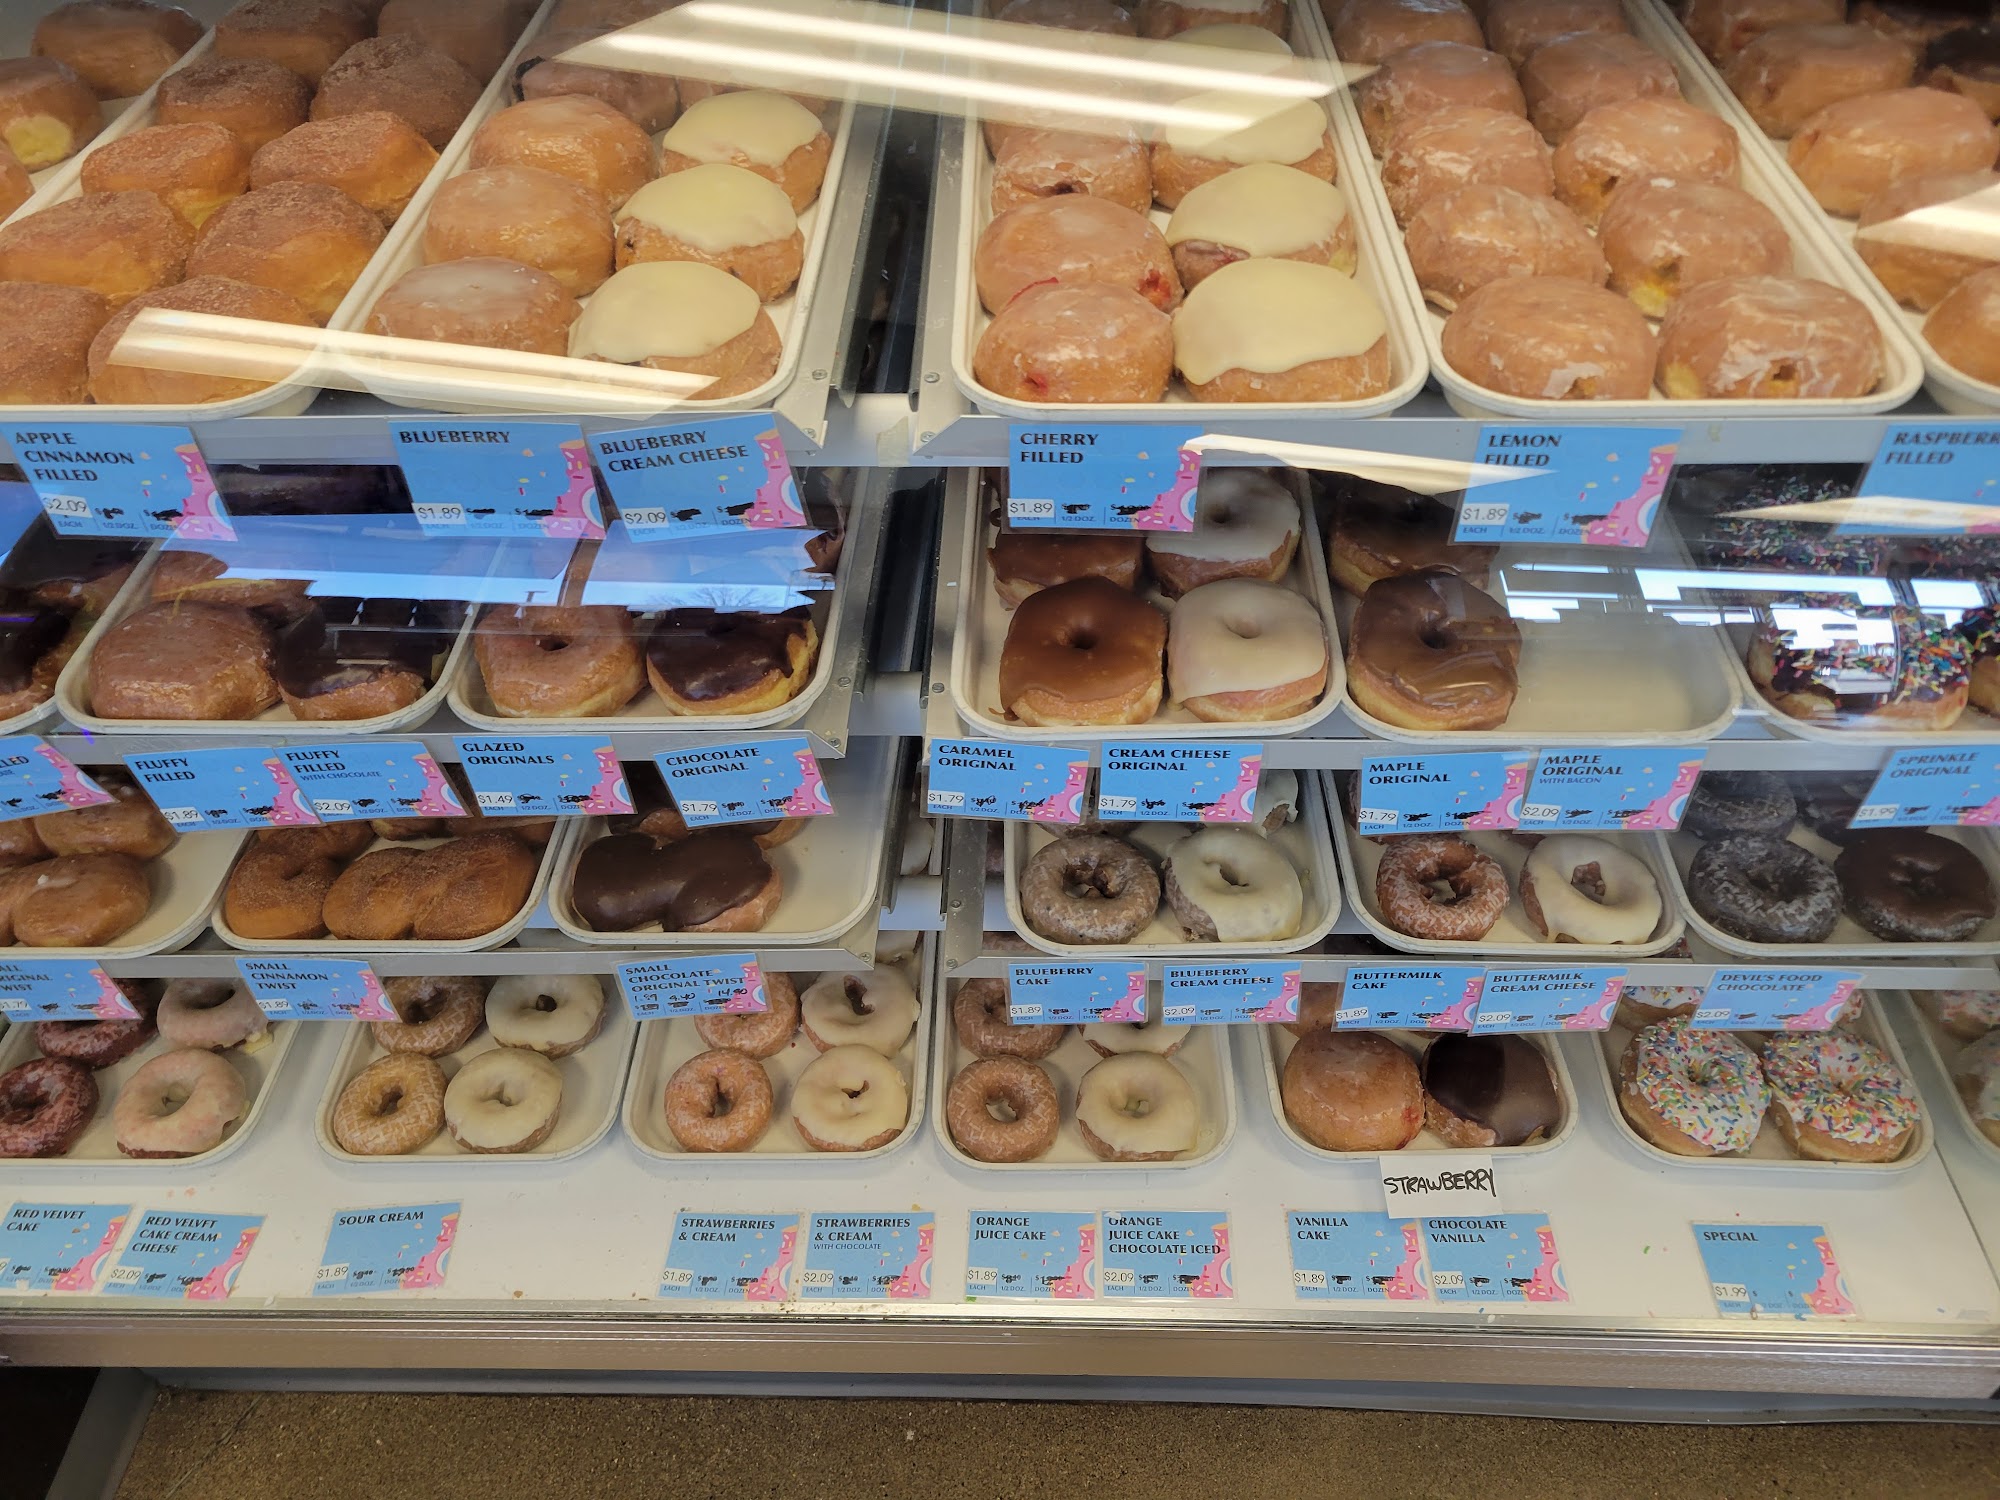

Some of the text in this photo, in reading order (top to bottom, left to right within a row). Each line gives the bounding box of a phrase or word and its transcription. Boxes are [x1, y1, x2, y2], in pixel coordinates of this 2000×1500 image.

[16, 432, 77, 445] APPLE
[400, 431, 510, 443] BLUEBERRY
[1020, 433, 1099, 445] CHERRY
[1488, 435, 1562, 447] LEMON
[600, 431, 706, 455] BLUEBERRY
[24, 450, 135, 465] CINNAMON
[609, 446, 749, 472] CREAM CHEESE
[1021, 452, 1084, 464] FILLED
[1485, 454, 1549, 466] FILLED
[1885, 452, 1954, 464] FILLED
[34, 469, 98, 481] FILLED
[43, 497, 87, 513] $2.09
[1010, 502, 1053, 514] $1.89
[418, 508, 461, 519] $1.89
[624, 511, 666, 524] $2.09
[1462, 508, 1507, 521] $1.89
[462, 743, 524, 752] GLAZED
[939, 745, 1015, 759] CARAMEL
[286, 750, 340, 761] FLUFFY
[666, 748, 760, 766] CHOCOLATE
[1109, 749, 1231, 759] CREAM CHEESE
[1897, 752, 1979, 765] SPRINKLE
[135, 758, 189, 770] FLUFFY
[468, 756, 555, 765] ORIGINALS
[939, 757, 1016, 771] ORIGINAL
[1545, 755, 1602, 765] MAPLE
[294, 763, 345, 773] FILLED
[672, 763, 749, 778] ORIGINAL
[1108, 761, 1187, 771] ORIGINAL
[1370, 762, 1425, 772] MAPLE
[1542, 766, 1623, 776] ORIGINAL
[144, 771, 195, 782] FILLED
[327, 771, 382, 779] CHOCOLATE
[1890, 765, 1972, 778] ORIGINAL
[1370, 774, 1451, 784] ORIGINAL
[478, 795, 513, 804] $1.49
[929, 793, 964, 803] $1.79
[1101, 798, 1136, 808] $1.79
[315, 802, 351, 811] $2.09
[682, 803, 717, 812] $1.79
[164, 810, 198, 821] $1.89
[1359, 811, 1397, 821] $1.79
[1522, 807, 1559, 817] $2.09
[626, 965, 672, 974] SMALL
[1016, 967, 1094, 976] BLUEBERRY
[1171, 968, 1250, 978] BLUEBERRY
[629, 970, 713, 983] CHOCOLATE
[1354, 972, 1443, 980] BUTTERMILK
[1493, 973, 1583, 982] BUTTERMILK
[632, 981, 700, 992] ORIGINAL
[1337, 1009, 1368, 1019] $1.89
[1479, 1014, 1510, 1022] $2.09
[1384, 1168, 1496, 1197] STRAWBERRY
[14, 1209, 85, 1219] RED VELVET
[339, 1211, 424, 1226] SOUR CREAM
[146, 1217, 171, 1225] RED
[682, 1219, 775, 1229] STRAWBERRIES
[816, 1219, 910, 1227] STRAWBERRIES
[976, 1217, 1030, 1226] ORANGE
[1109, 1217, 1162, 1226] ORANGE
[1295, 1217, 1348, 1226] VANILLA
[1429, 1220, 1508, 1229] CHOCOLATE
[7, 1222, 40, 1232] CAKE
[139, 1229, 217, 1242] CAKE CREAM
[679, 1232, 736, 1242] & CREAM
[815, 1232, 872, 1241] & CREAM
[975, 1230, 1046, 1240] JUICE CAKE
[1109, 1230, 1180, 1240] JUICE CAKE
[1297, 1231, 1331, 1240] CAKE
[1431, 1233, 1485, 1243] VANILLA
[1703, 1232, 1759, 1241] SPECIAL
[132, 1243, 179, 1254] CHEESE
[1109, 1244, 1220, 1254] CHOCOLATE ICED
[111, 1269, 141, 1280] $2.09
[317, 1266, 348, 1279] $1.89
[663, 1271, 693, 1282] $1.89
[804, 1272, 833, 1283] $2.09
[968, 1270, 997, 1281] $1.89
[1104, 1271, 1134, 1282] $2.09
[1295, 1273, 1324, 1284] $1.89
[1434, 1275, 1464, 1285] $2.09
[1715, 1286, 1747, 1296] $1.99
